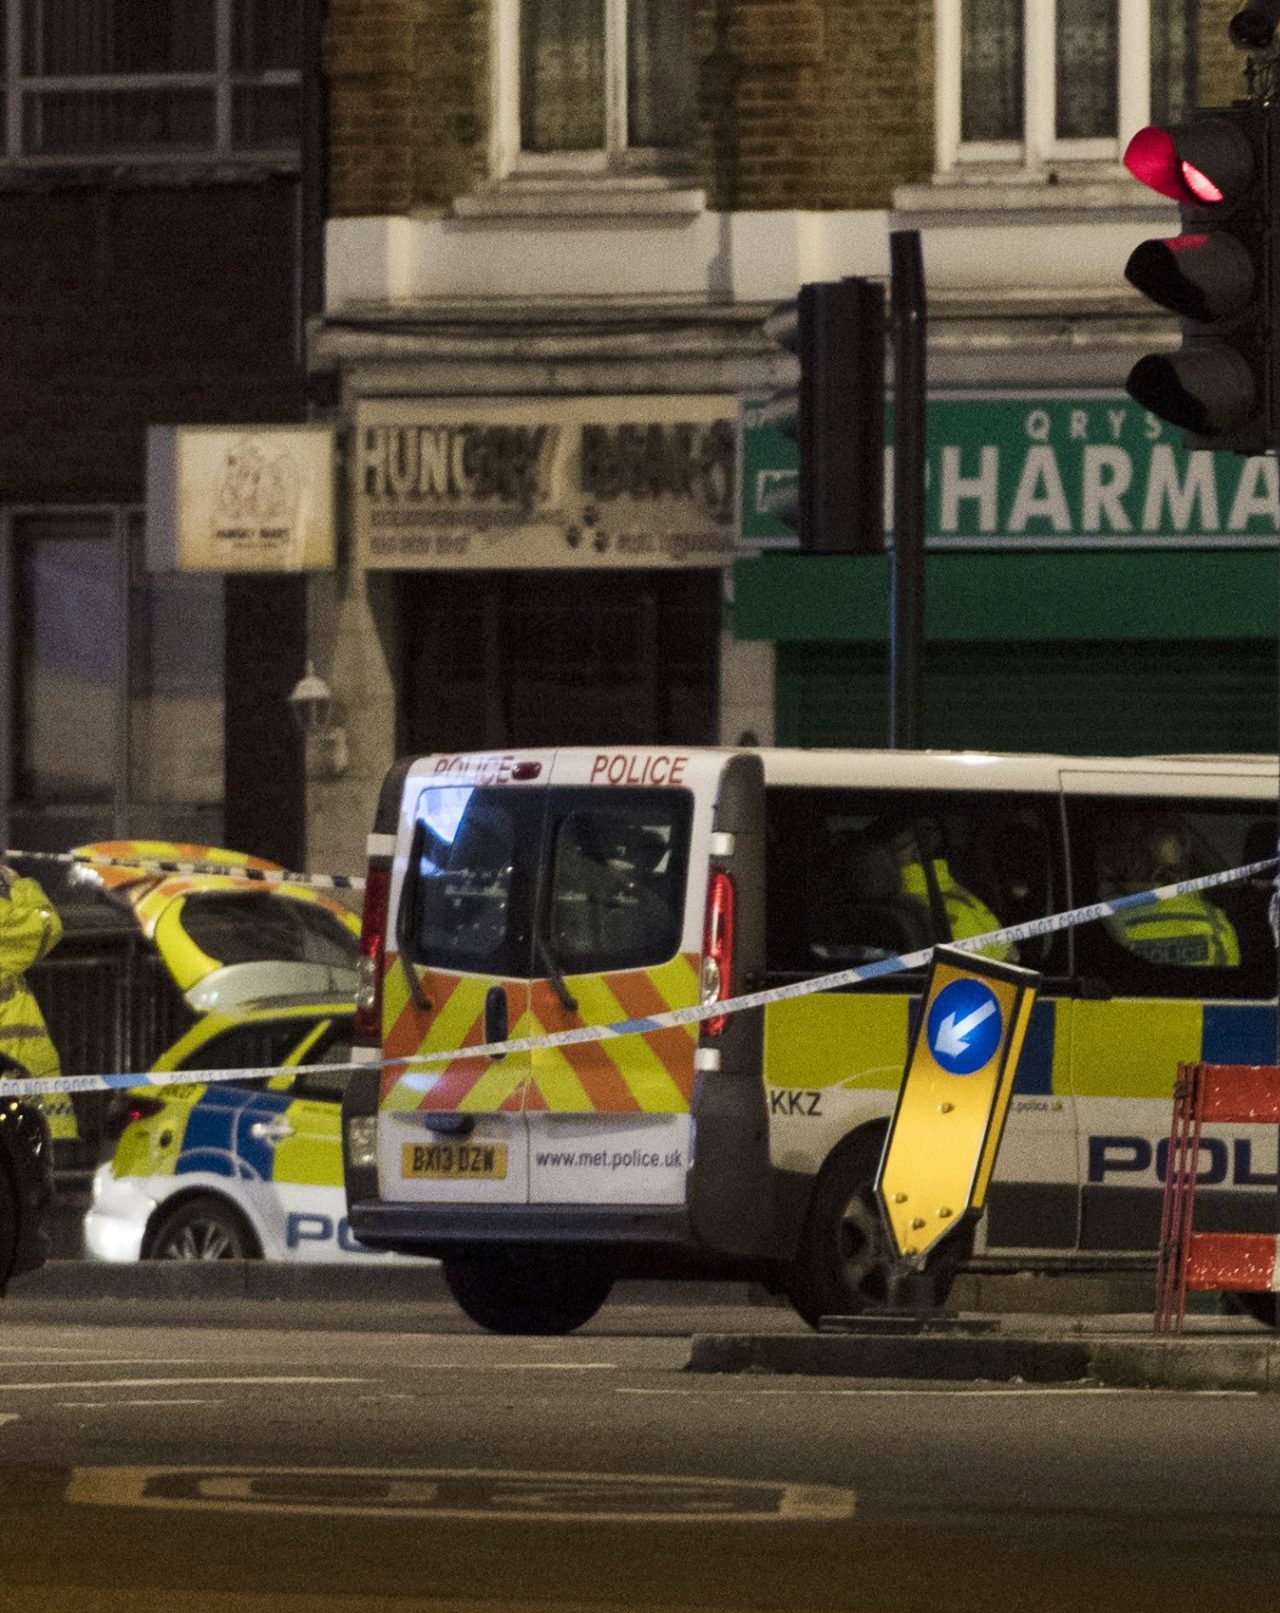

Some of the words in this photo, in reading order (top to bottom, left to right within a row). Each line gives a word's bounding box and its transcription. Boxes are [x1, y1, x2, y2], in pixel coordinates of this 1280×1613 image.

[1025, 409, 1162, 441] QRYS
[590, 755, 688, 785] POLICE
[770, 1090, 823, 1118] KKZ
[536, 1148, 682, 1170] www.met.police.uk
